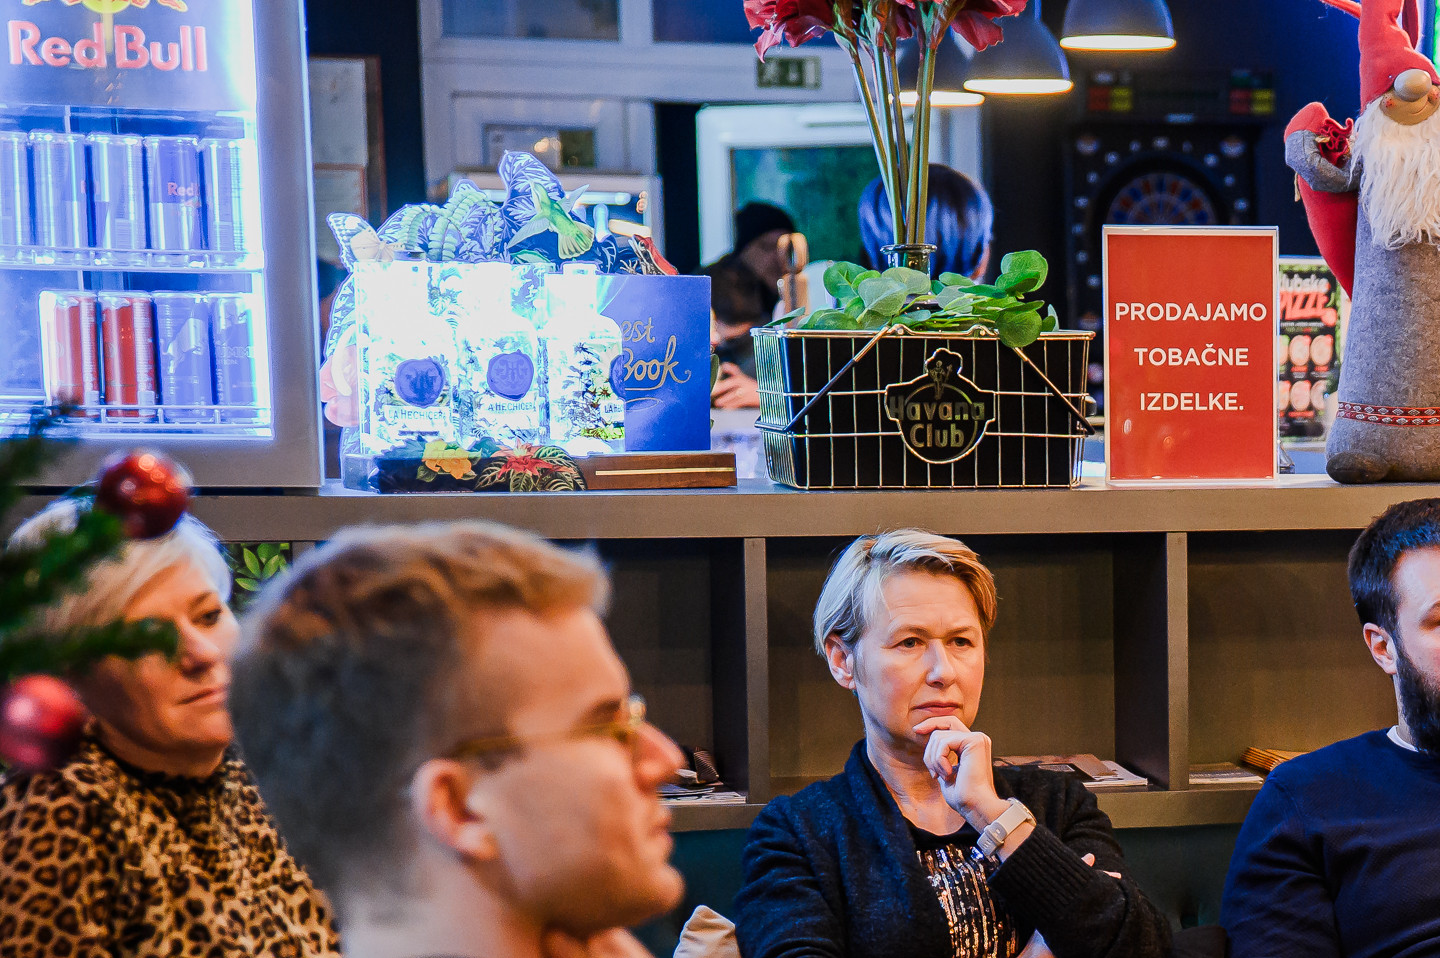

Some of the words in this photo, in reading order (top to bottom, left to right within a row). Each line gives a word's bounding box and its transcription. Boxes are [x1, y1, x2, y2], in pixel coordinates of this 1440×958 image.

[8, 20, 107, 69] Red
[114, 25, 209, 71] Bull
[1115, 302, 1267, 321] PRODAJAMO
[1134, 343, 1249, 366] TOBAČNE
[888, 395, 985, 421] Havana
[1140, 392, 1244, 411] IZDELKE.
[910, 423, 965, 448] Club
